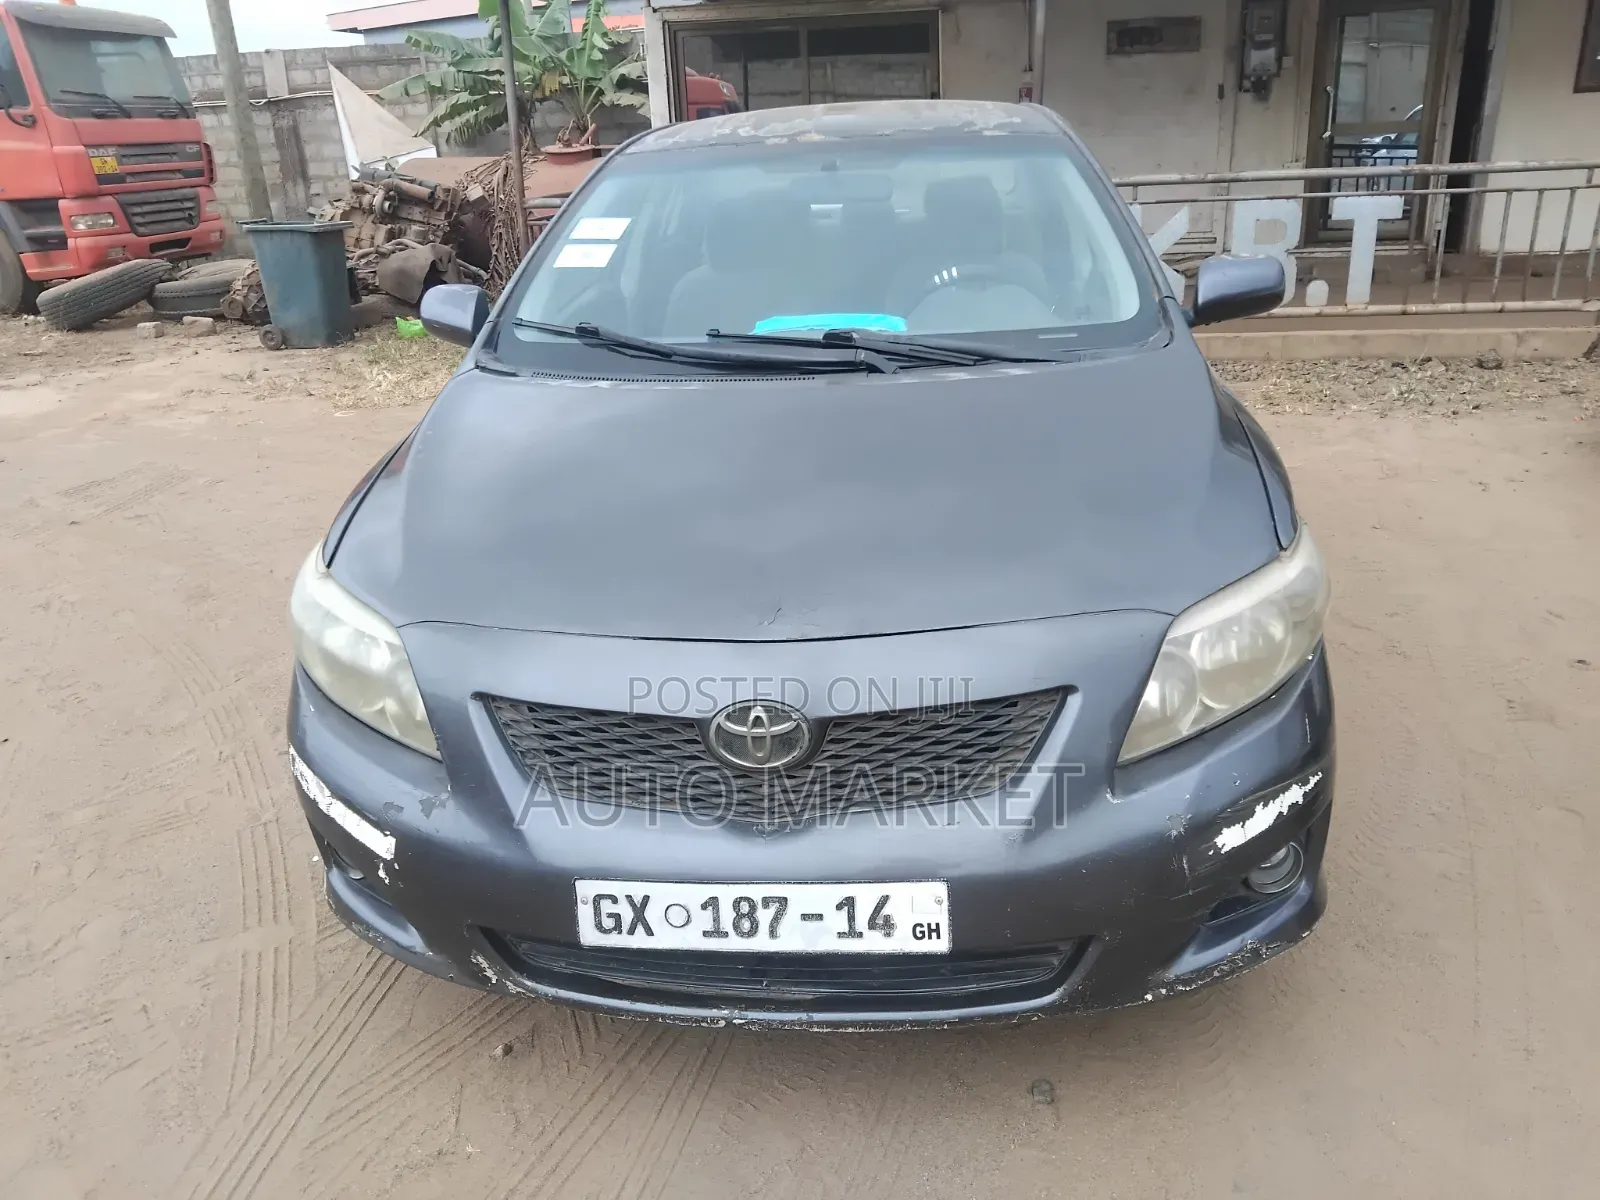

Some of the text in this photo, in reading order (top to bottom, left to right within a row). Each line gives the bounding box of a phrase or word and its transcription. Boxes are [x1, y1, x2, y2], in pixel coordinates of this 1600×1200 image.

[87, 147, 117, 157] DAF
[184, 145, 200, 153] CF
[592, 893, 655, 937] GX
[912, 922, 942, 941] GH
